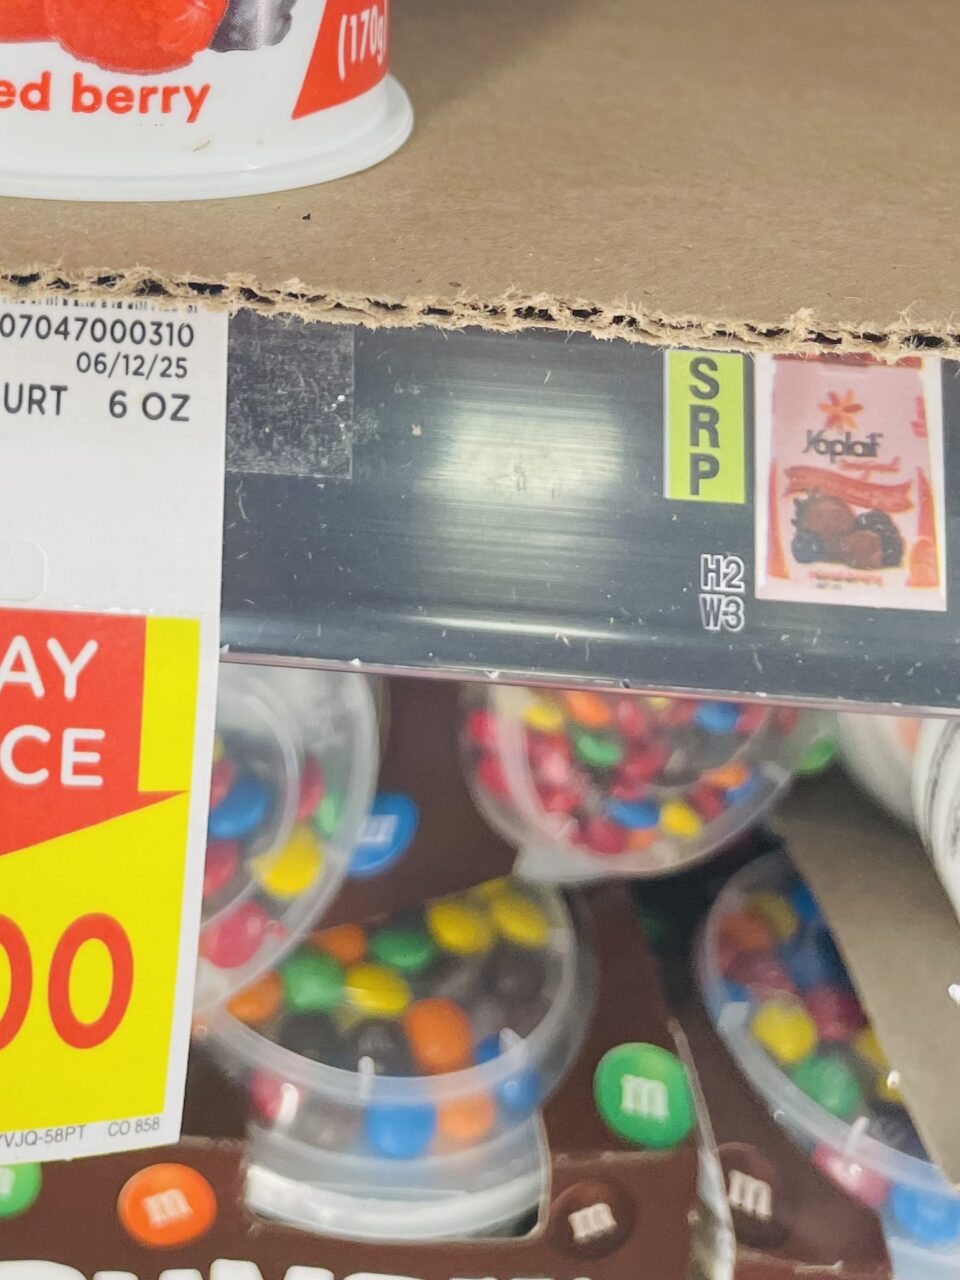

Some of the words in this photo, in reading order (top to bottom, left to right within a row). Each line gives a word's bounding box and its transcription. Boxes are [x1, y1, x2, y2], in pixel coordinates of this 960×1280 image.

[71, 72, 210, 123] berry
[76, 351, 189, 380] 06/12/25
[108, 390, 128, 419] 6
[141, 392, 191, 422] OZ
[700, 554, 745, 592] H2
[698, 594, 745, 632] W3
[107, 1121, 131, 1137] CO
[135, 1116, 161, 1133] 858
